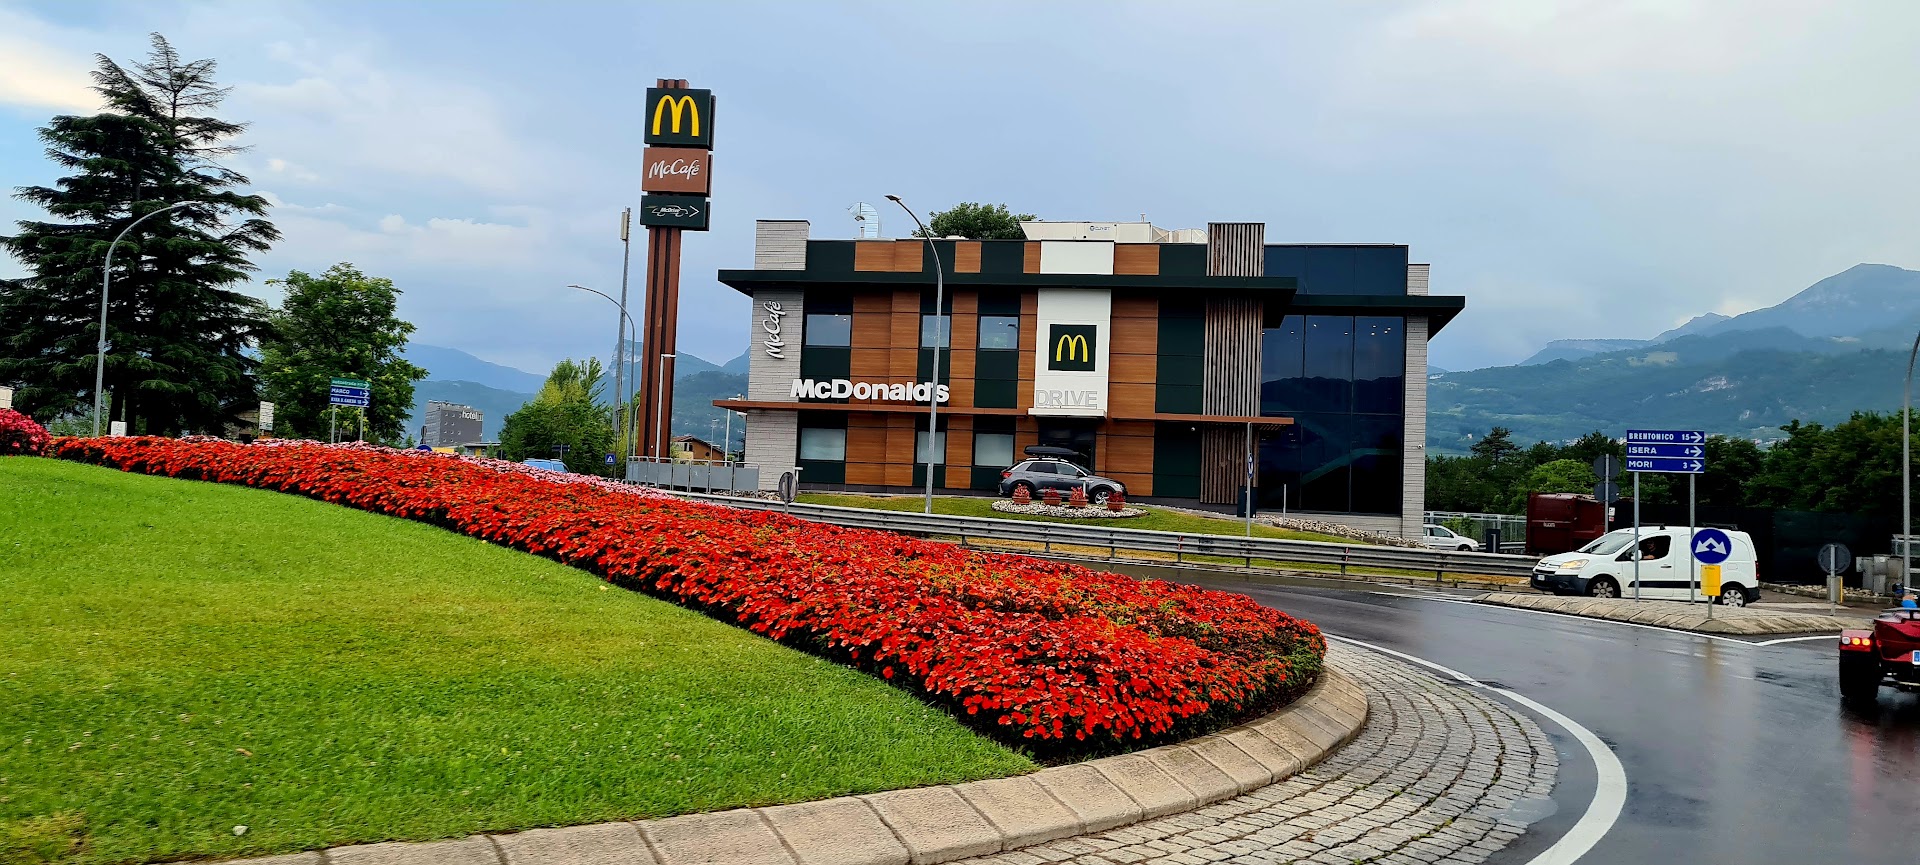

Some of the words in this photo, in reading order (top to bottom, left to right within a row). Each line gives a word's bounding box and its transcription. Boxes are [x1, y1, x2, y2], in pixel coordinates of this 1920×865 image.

[648, 159, 700, 180] McCafé
[763, 301, 785, 358] McCafé
[1035, 389, 1098, 407] DRIVE
[462, 410, 477, 419] hotel
[1629, 432, 1674, 440] BRENTONICO
